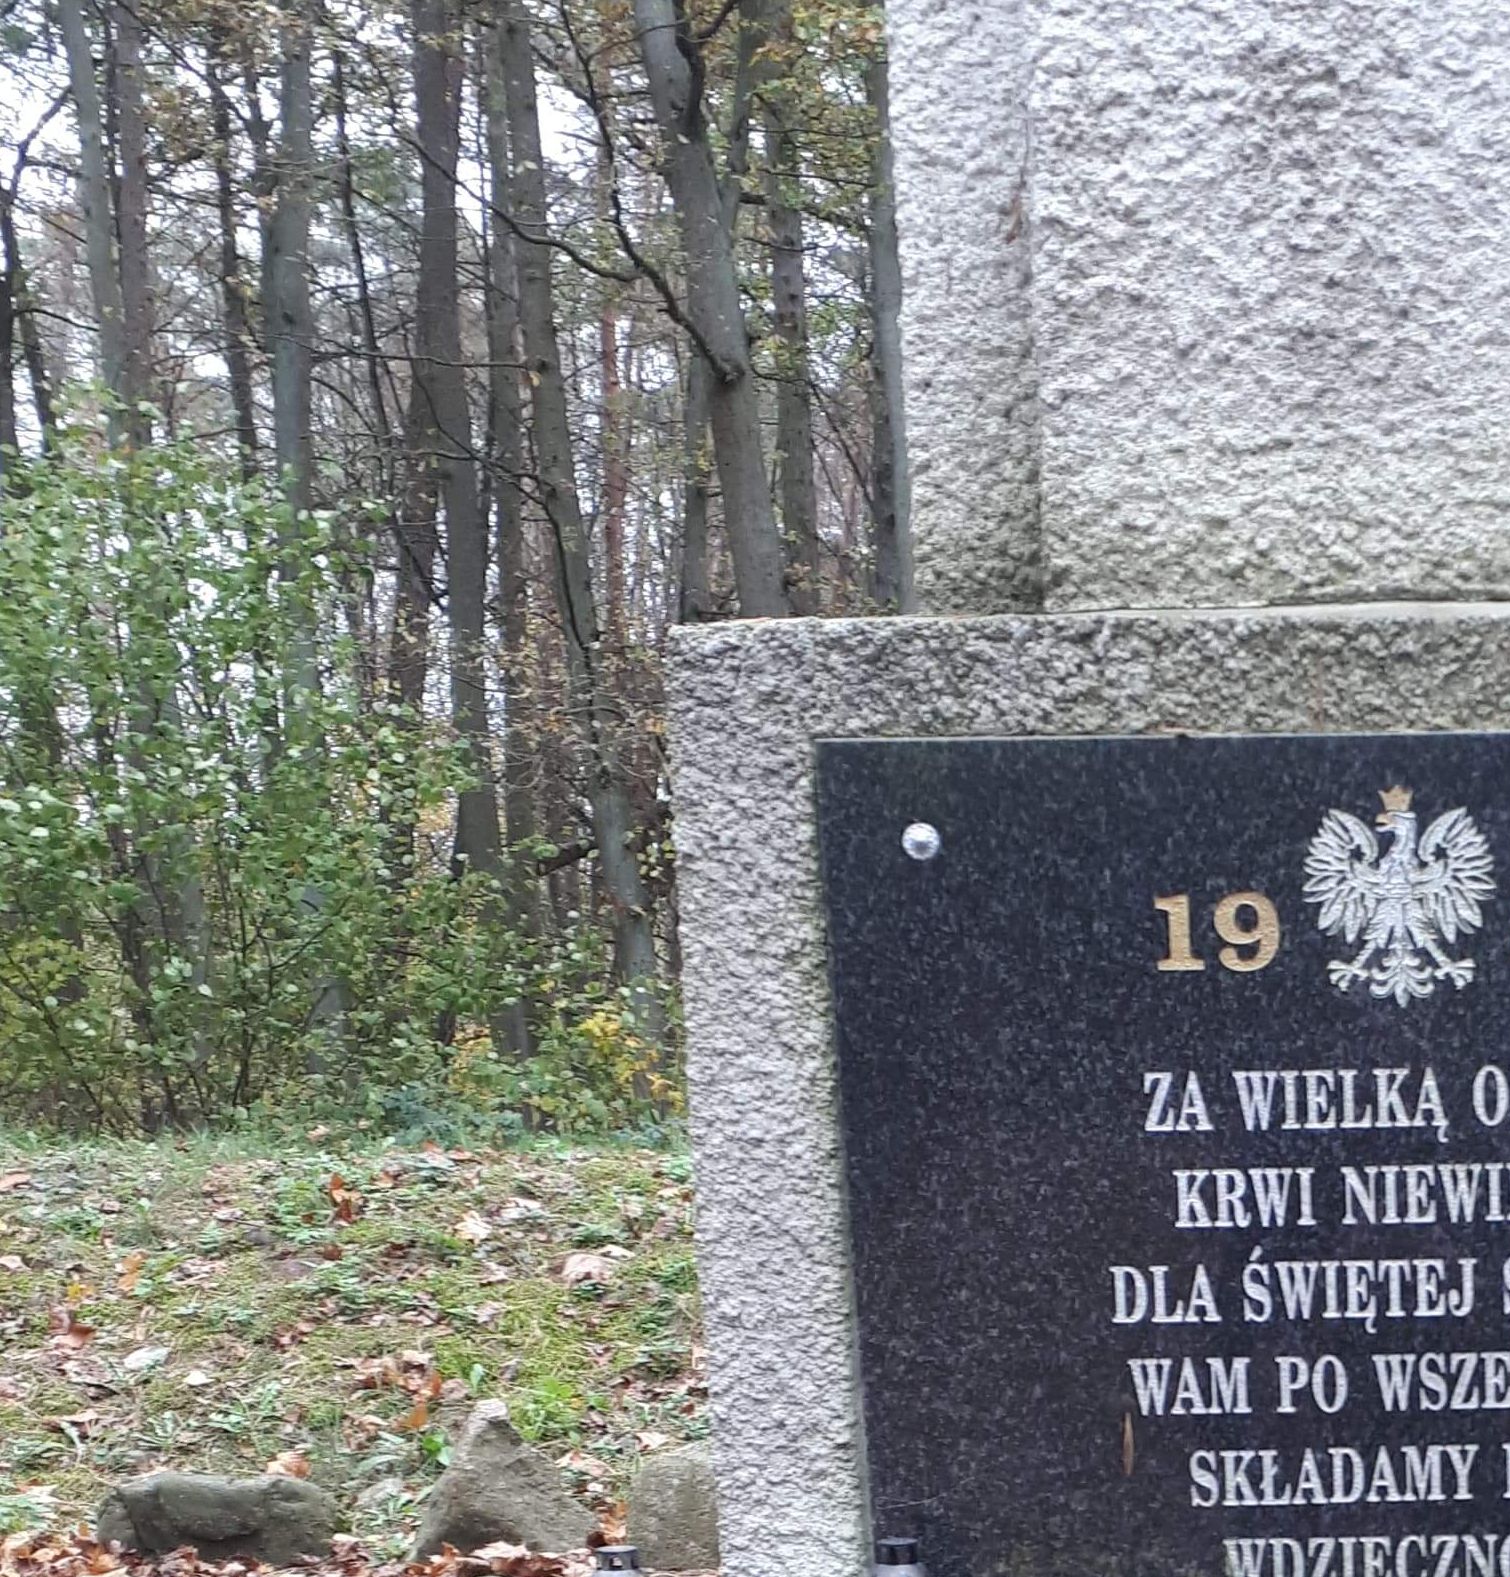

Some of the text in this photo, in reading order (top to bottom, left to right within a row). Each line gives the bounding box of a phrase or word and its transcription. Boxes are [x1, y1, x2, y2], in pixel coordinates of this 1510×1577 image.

[1153, 892, 1281, 973] 19
[1142, 1070, 1215, 1133] ZA
[1231, 1065, 1451, 1144] WIELKĄ
[1171, 1166, 1318, 1229] KRWI
[1108, 1263, 1223, 1325] DLA
[1242, 1245, 1479, 1334] ŚWIĘTEJ
[1126, 1355, 1253, 1417] WAM
[1274, 1354, 1350, 1415] PO
[1189, 1444, 1480, 1509] SKŁADAMY
